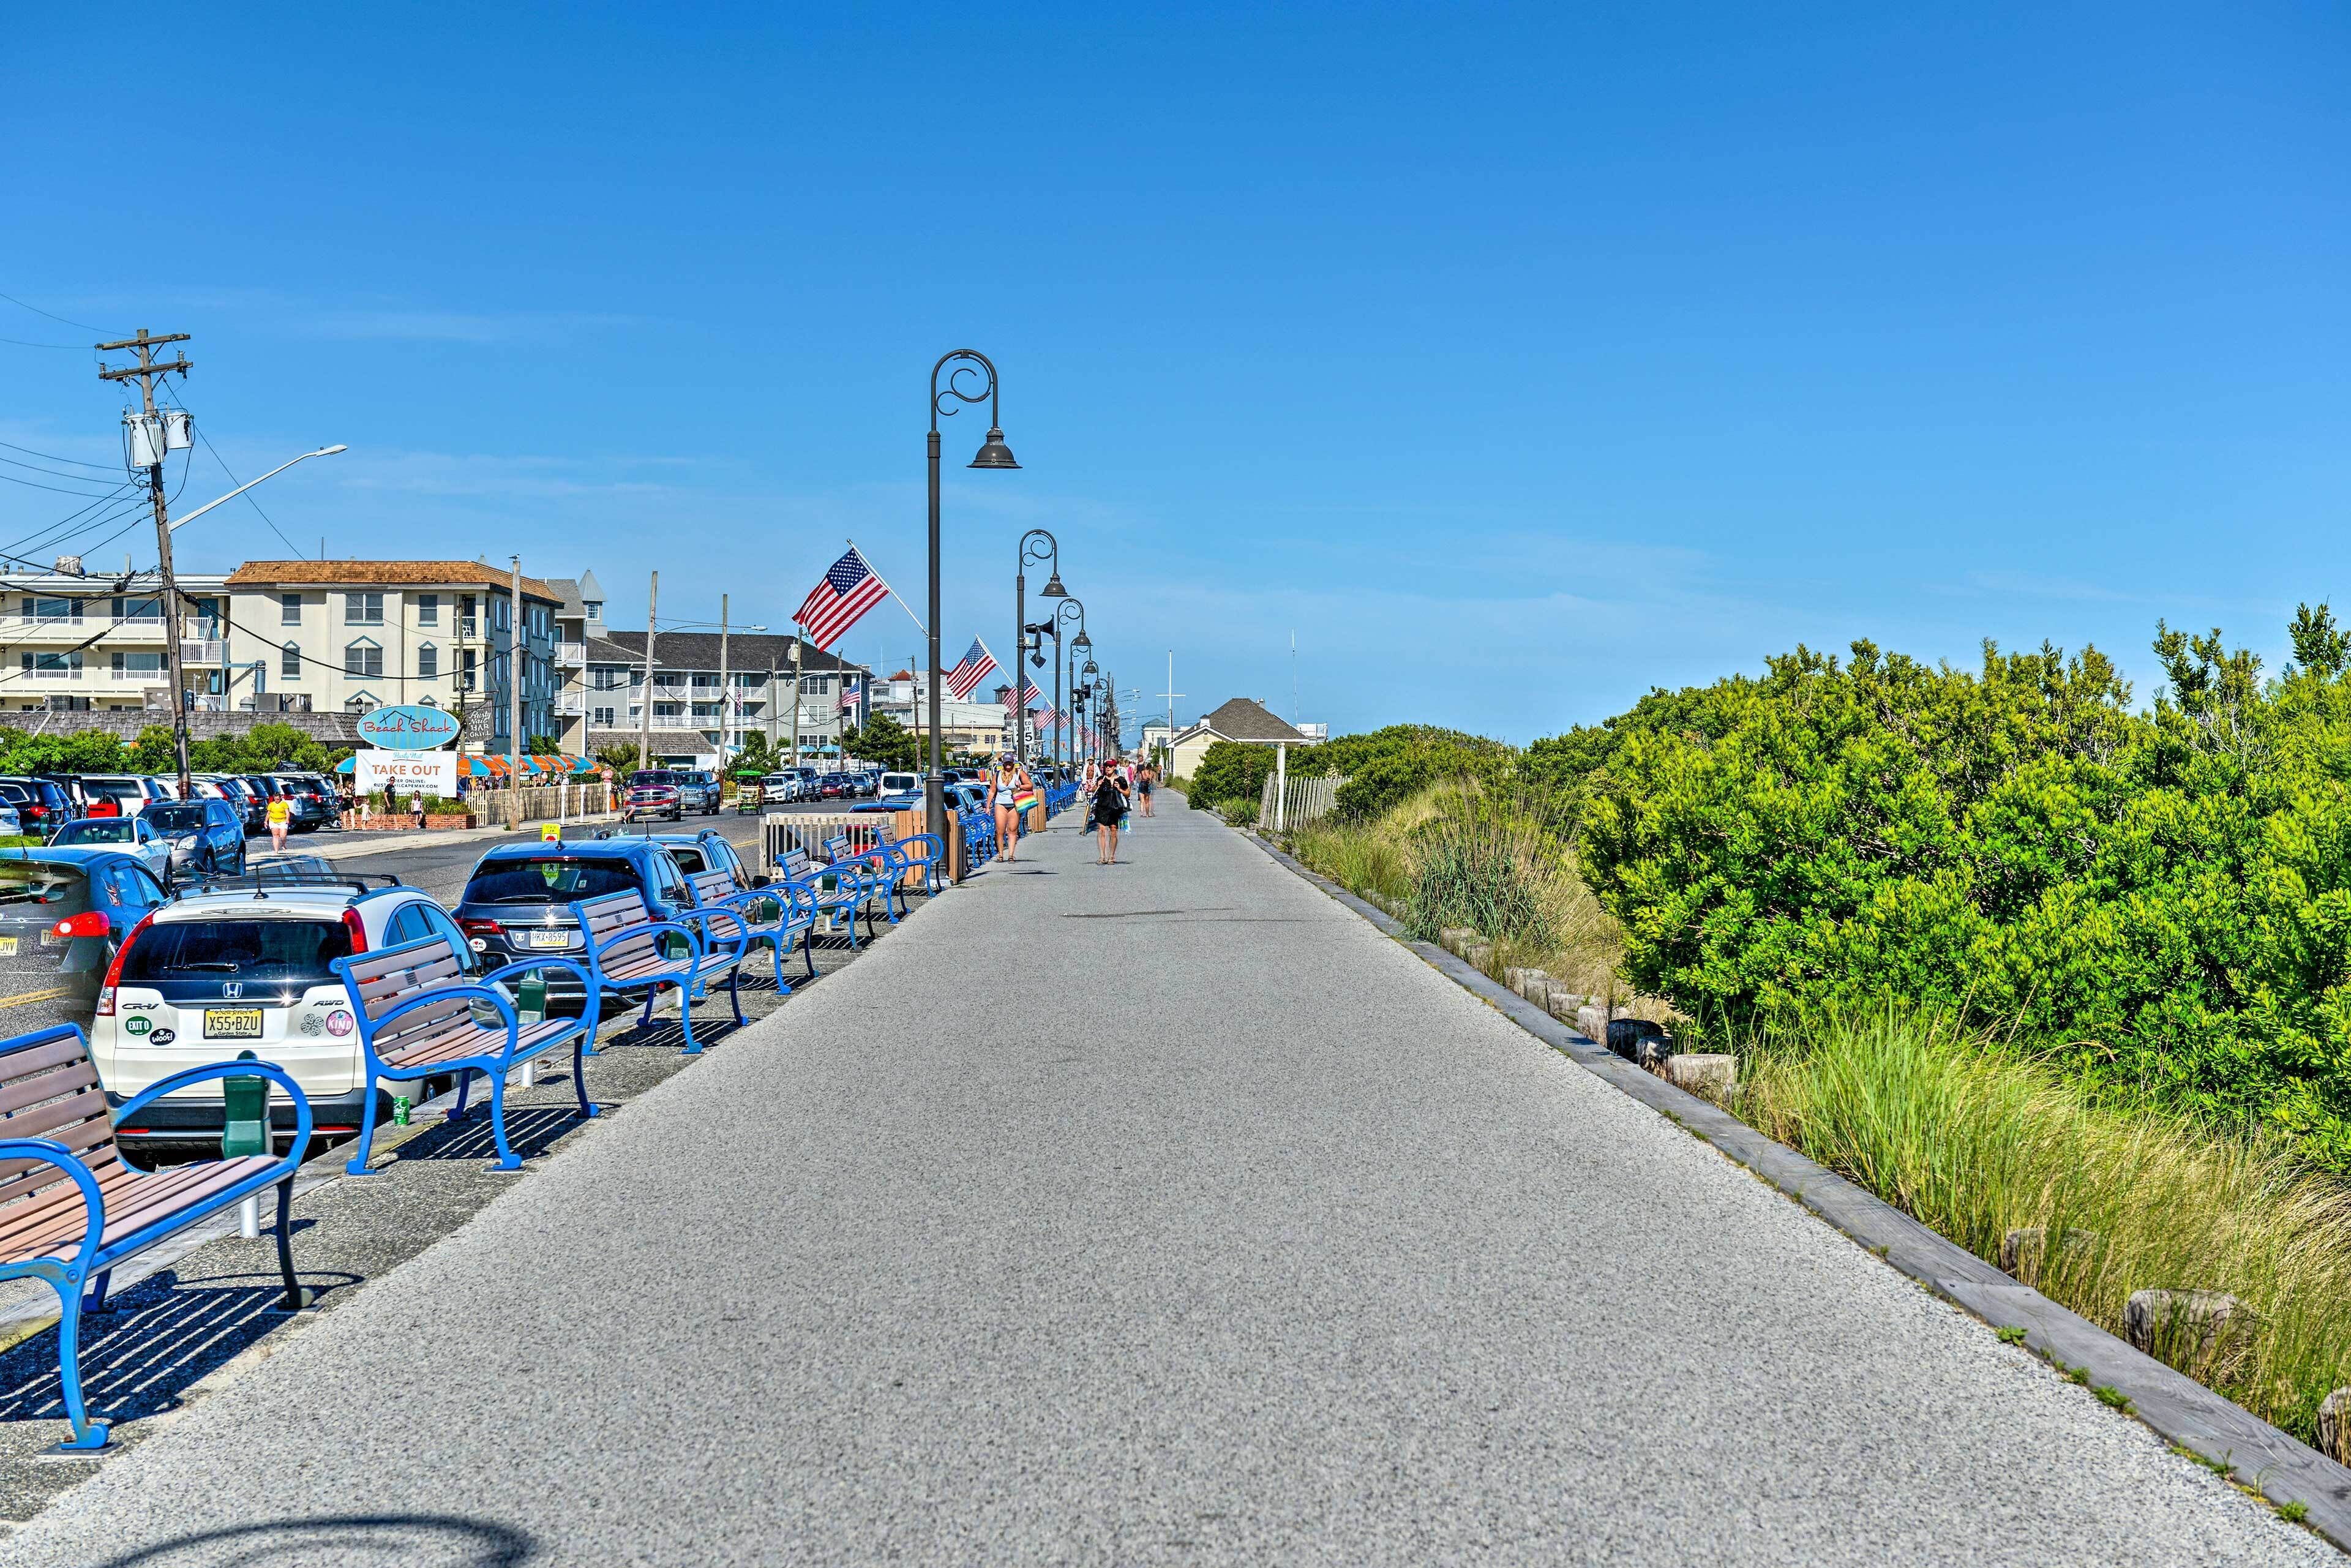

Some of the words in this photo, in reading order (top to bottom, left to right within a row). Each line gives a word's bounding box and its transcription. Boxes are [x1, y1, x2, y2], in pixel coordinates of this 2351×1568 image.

[468, 710, 491, 719] Rusty
[363, 718, 405, 732] Beach
[410, 718, 454, 733] Shack
[372, 765, 407, 775] TAKE
[411, 765, 441, 776] OUT
[128, 1021, 143, 1030] EXIT
[328, 1019, 352, 1030] KIND
